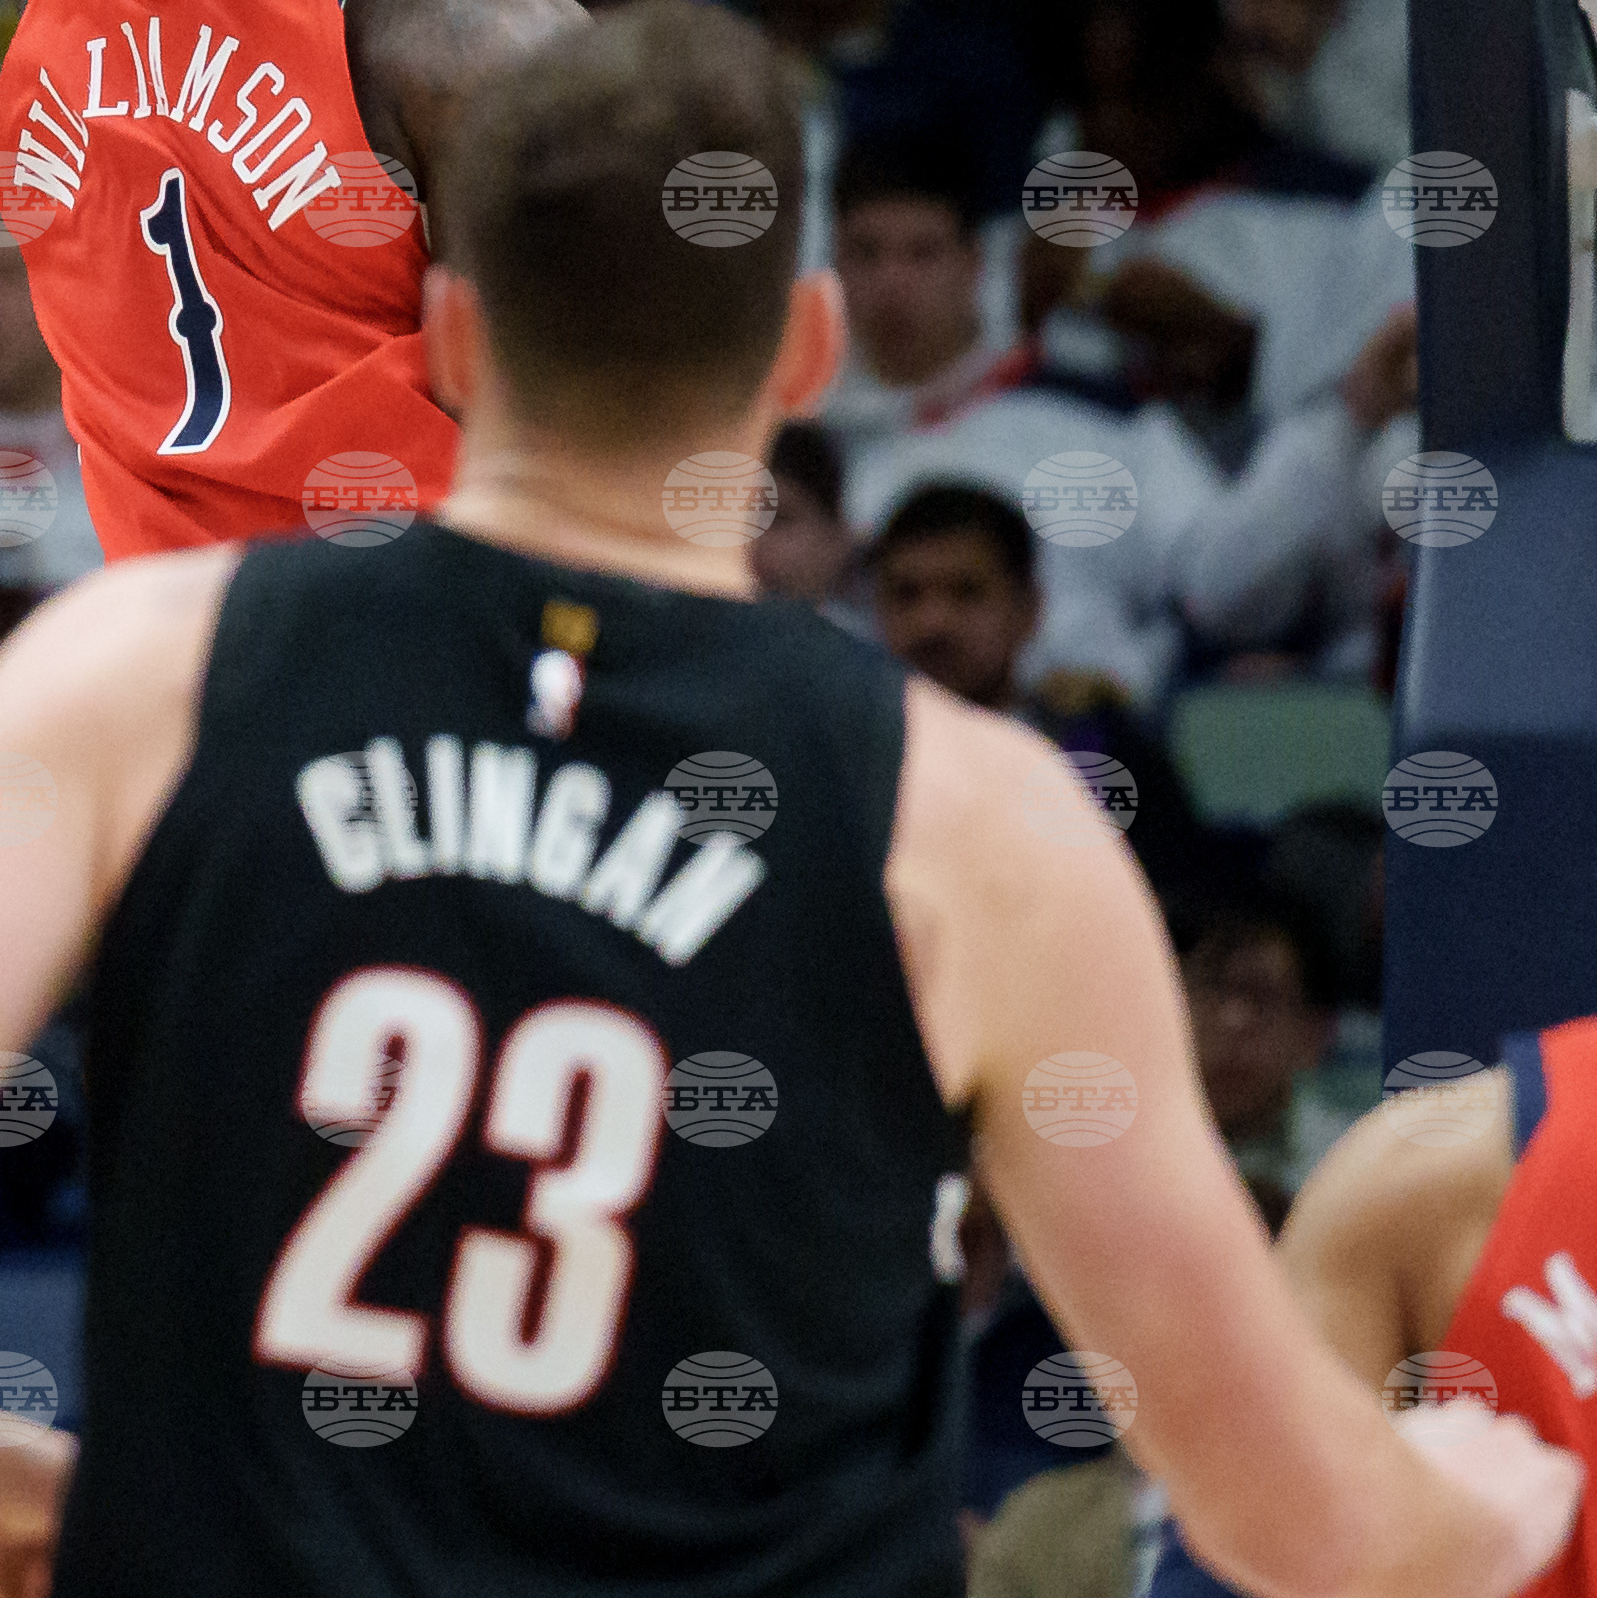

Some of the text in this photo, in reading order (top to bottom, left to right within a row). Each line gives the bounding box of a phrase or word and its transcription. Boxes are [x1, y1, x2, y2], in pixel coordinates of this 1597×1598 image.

[13, 16, 343, 232] WILLIAMSON
[140, 166, 233, 457] 1
[293, 734, 768, 967] CLINGAN
[251, 963, 670, 1418] 23
